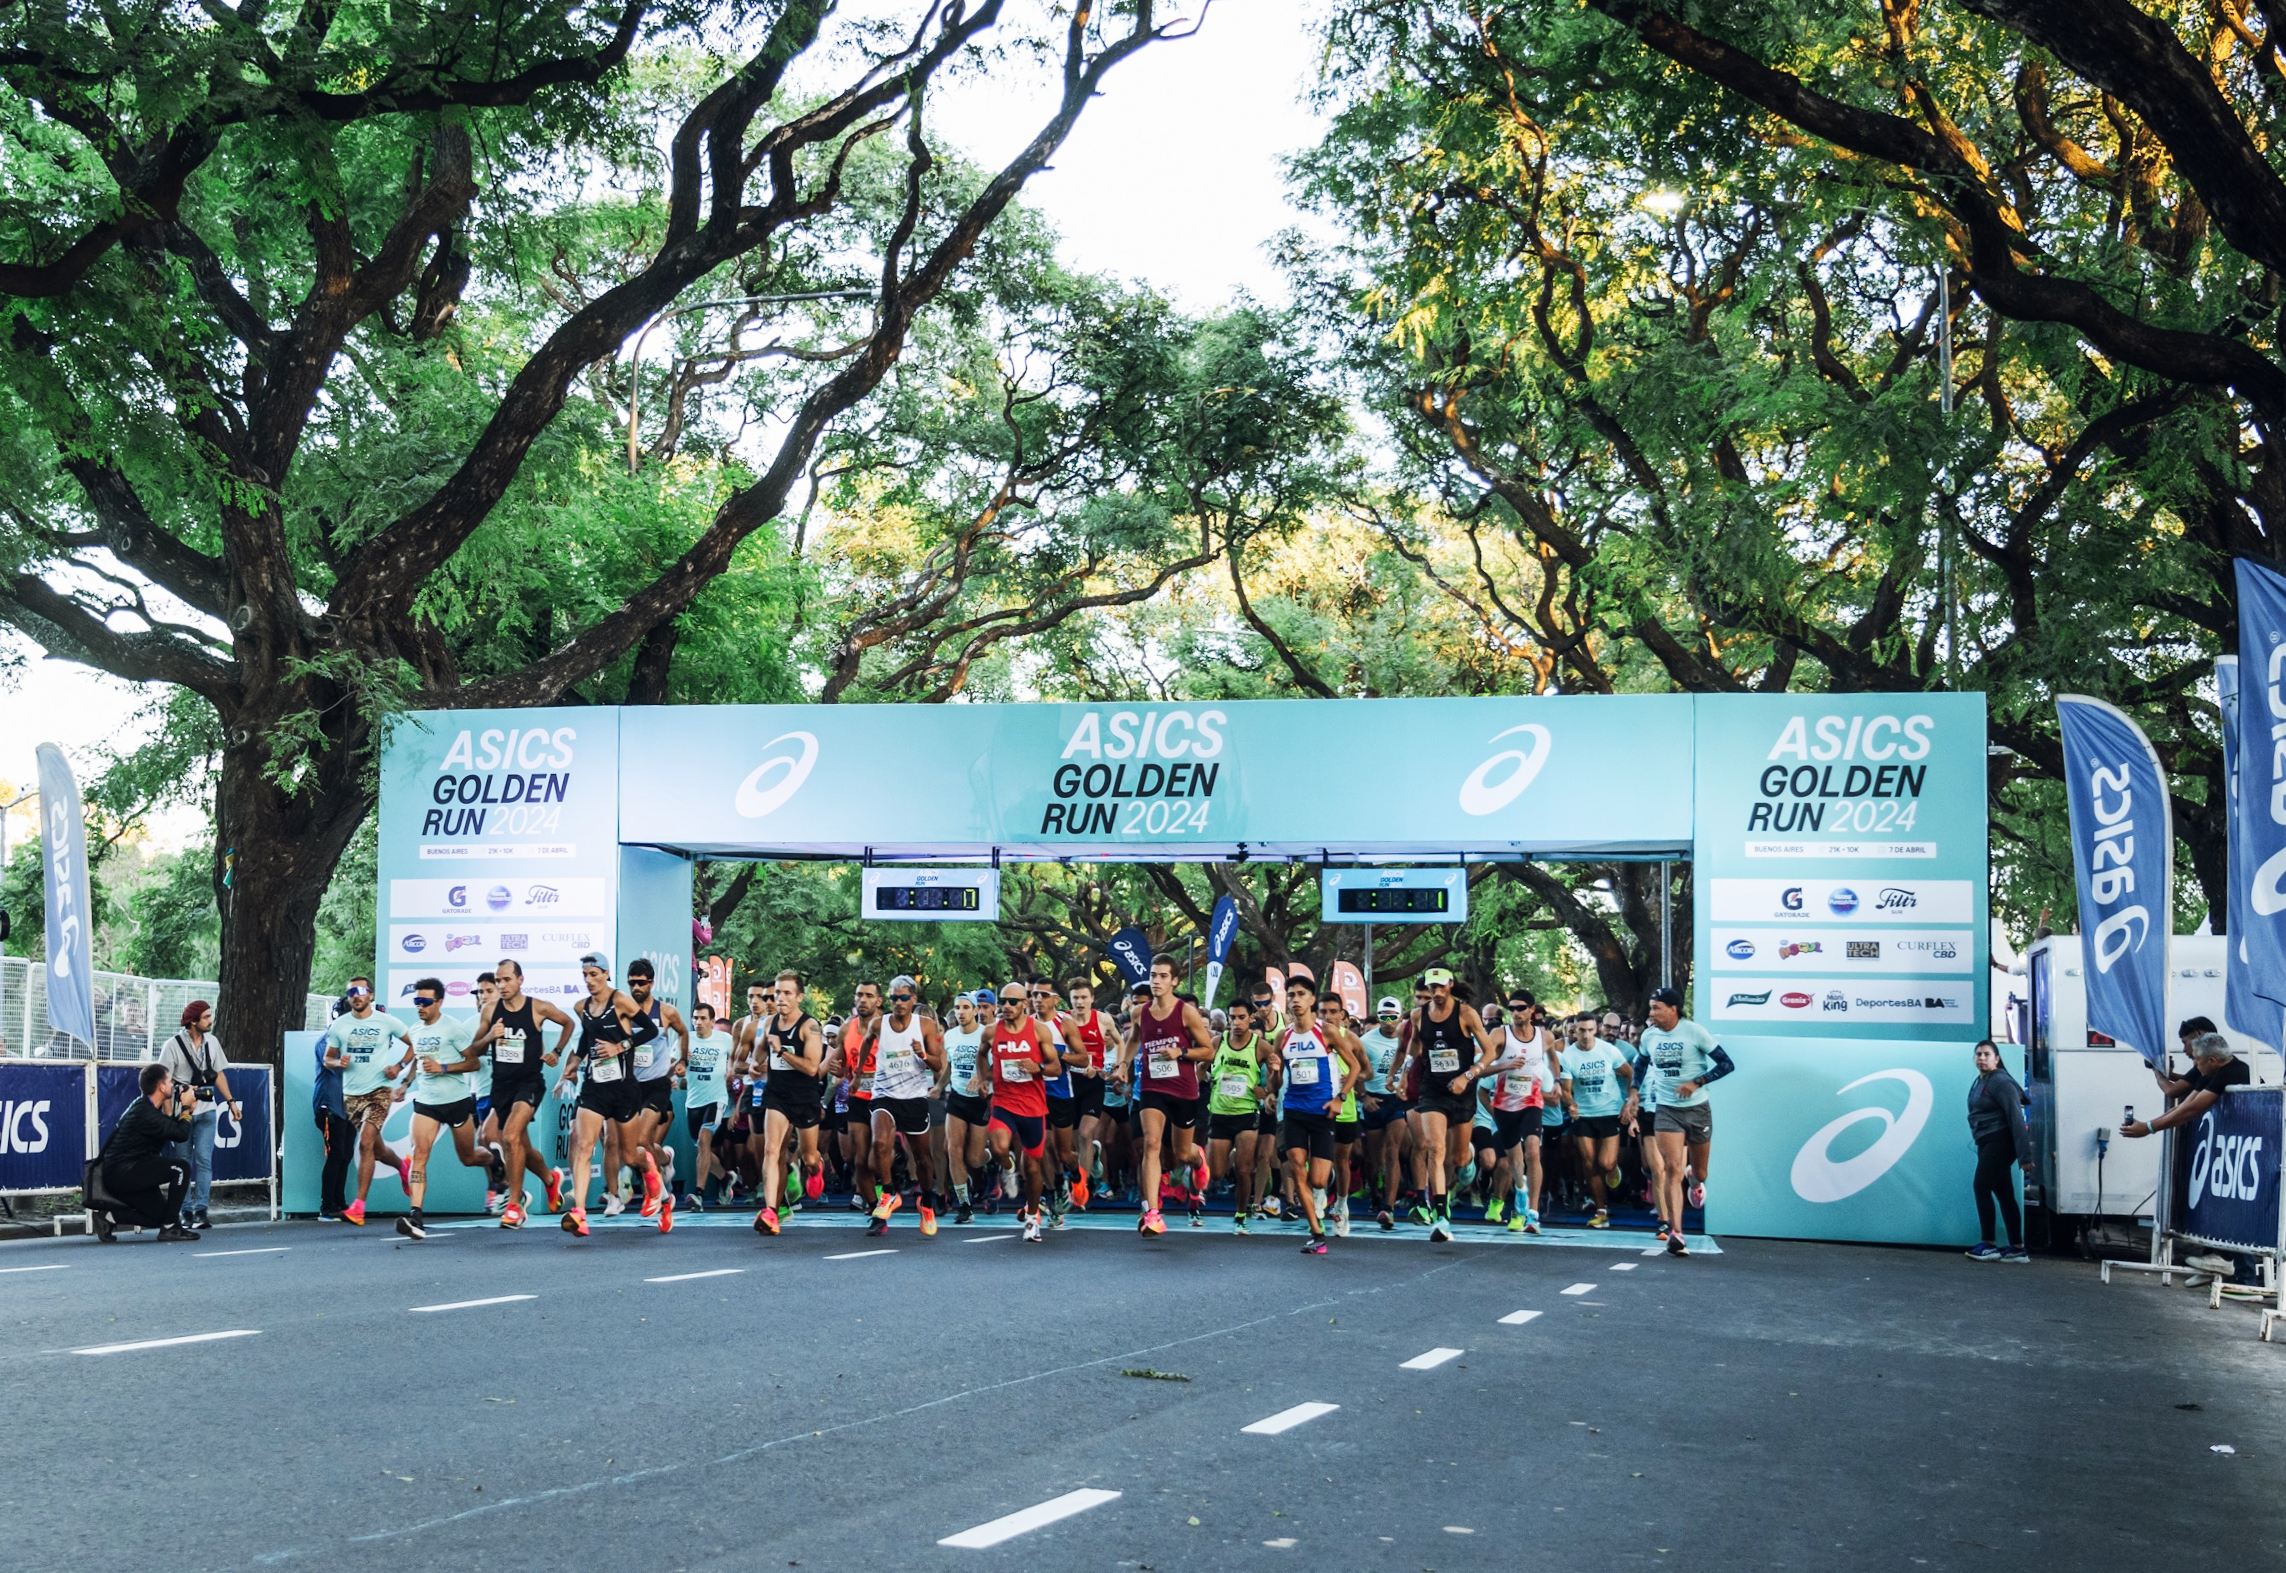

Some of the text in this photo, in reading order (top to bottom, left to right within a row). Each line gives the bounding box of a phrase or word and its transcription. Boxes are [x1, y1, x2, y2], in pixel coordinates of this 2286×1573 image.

[1060, 710, 1227, 759] ASICS
[1766, 715, 1934, 760] ASICS
[440, 727, 577, 771] ASICS
[1053, 762, 1220, 798] GOLDEN
[1760, 765, 1927, 798] GOLDEN
[433, 773, 570, 805] GOLDEN
[422, 806, 561, 836] RUN 2024
[1040, 800, 1210, 834] RUN 2024
[1747, 800, 1918, 832] RUN 2024
[1219, 908, 1234, 942] asics
[542, 934, 590, 942] CURFLEX
[1897, 941, 1956, 950] CURFLEX
[1124, 950, 1147, 976] asics
[1856, 998, 1922, 1009] DeportesBA
[504, 1027, 527, 1040] ILA
[693, 1047, 720, 1056] ASICS
[954, 1045, 978, 1053] ASICS
[998, 1040, 1031, 1053] FILA
[1289, 1041, 1316, 1052] FILA
[1656, 1042, 1684, 1050] ASICS
[889, 1060, 910, 1069] 4676
[1156, 1064, 1172, 1073] 506
[1434, 1060, 1454, 1068] 5633
[1580, 1060, 1605, 1070] ASICS
[1296, 1070, 1312, 1080] 501
[1227, 1084, 1242, 1092] 505
[1508, 1083, 1528, 1091] 4675
[2211, 1135, 2263, 1201] asics
